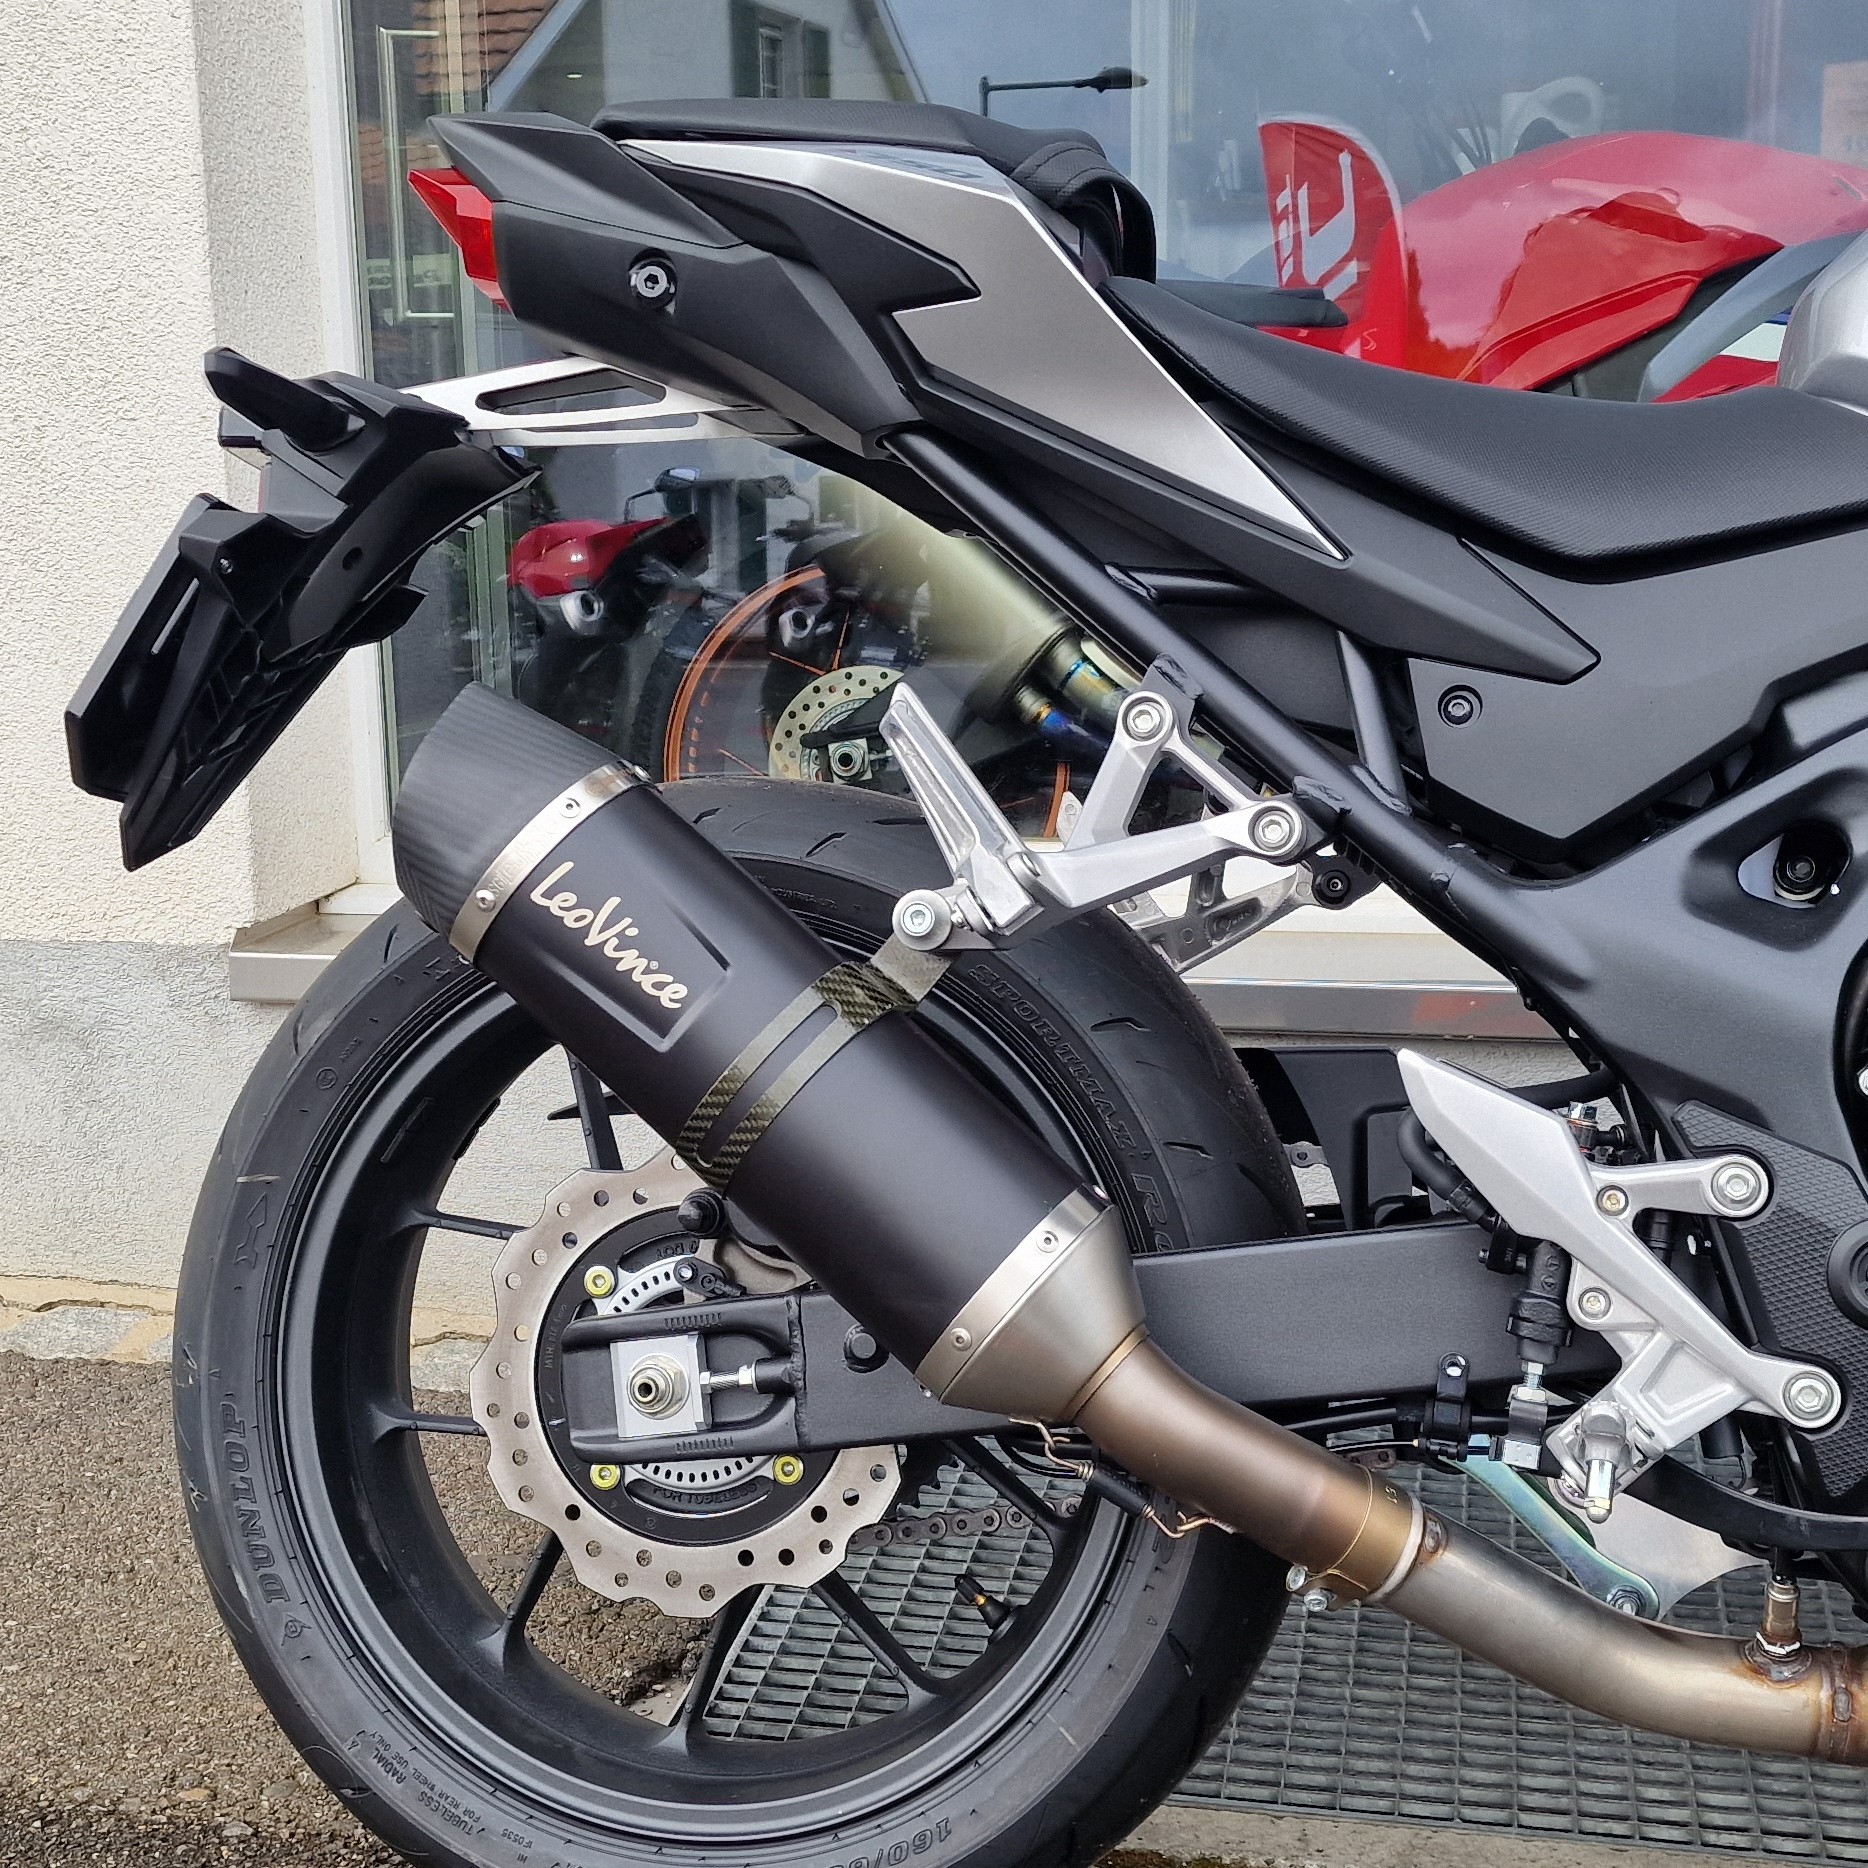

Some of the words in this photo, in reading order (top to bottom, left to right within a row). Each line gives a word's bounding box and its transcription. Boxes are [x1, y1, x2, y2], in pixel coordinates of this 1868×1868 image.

[530, 861, 688, 1009] LeoVince
[968, 964, 1137, 1149] SPORTMAX
[220, 1402, 291, 1604] DUNLOP
[369, 1730, 392, 1752] ONLY
[372, 1747, 407, 1785] RADIAL
[391, 1751, 409, 1770] USE
[411, 1767, 437, 1792] WHEEL
[418, 1790, 475, 1836] TUBELESS
[437, 1789, 461, 1810] REAR
[463, 1806, 482, 1823] FOR
